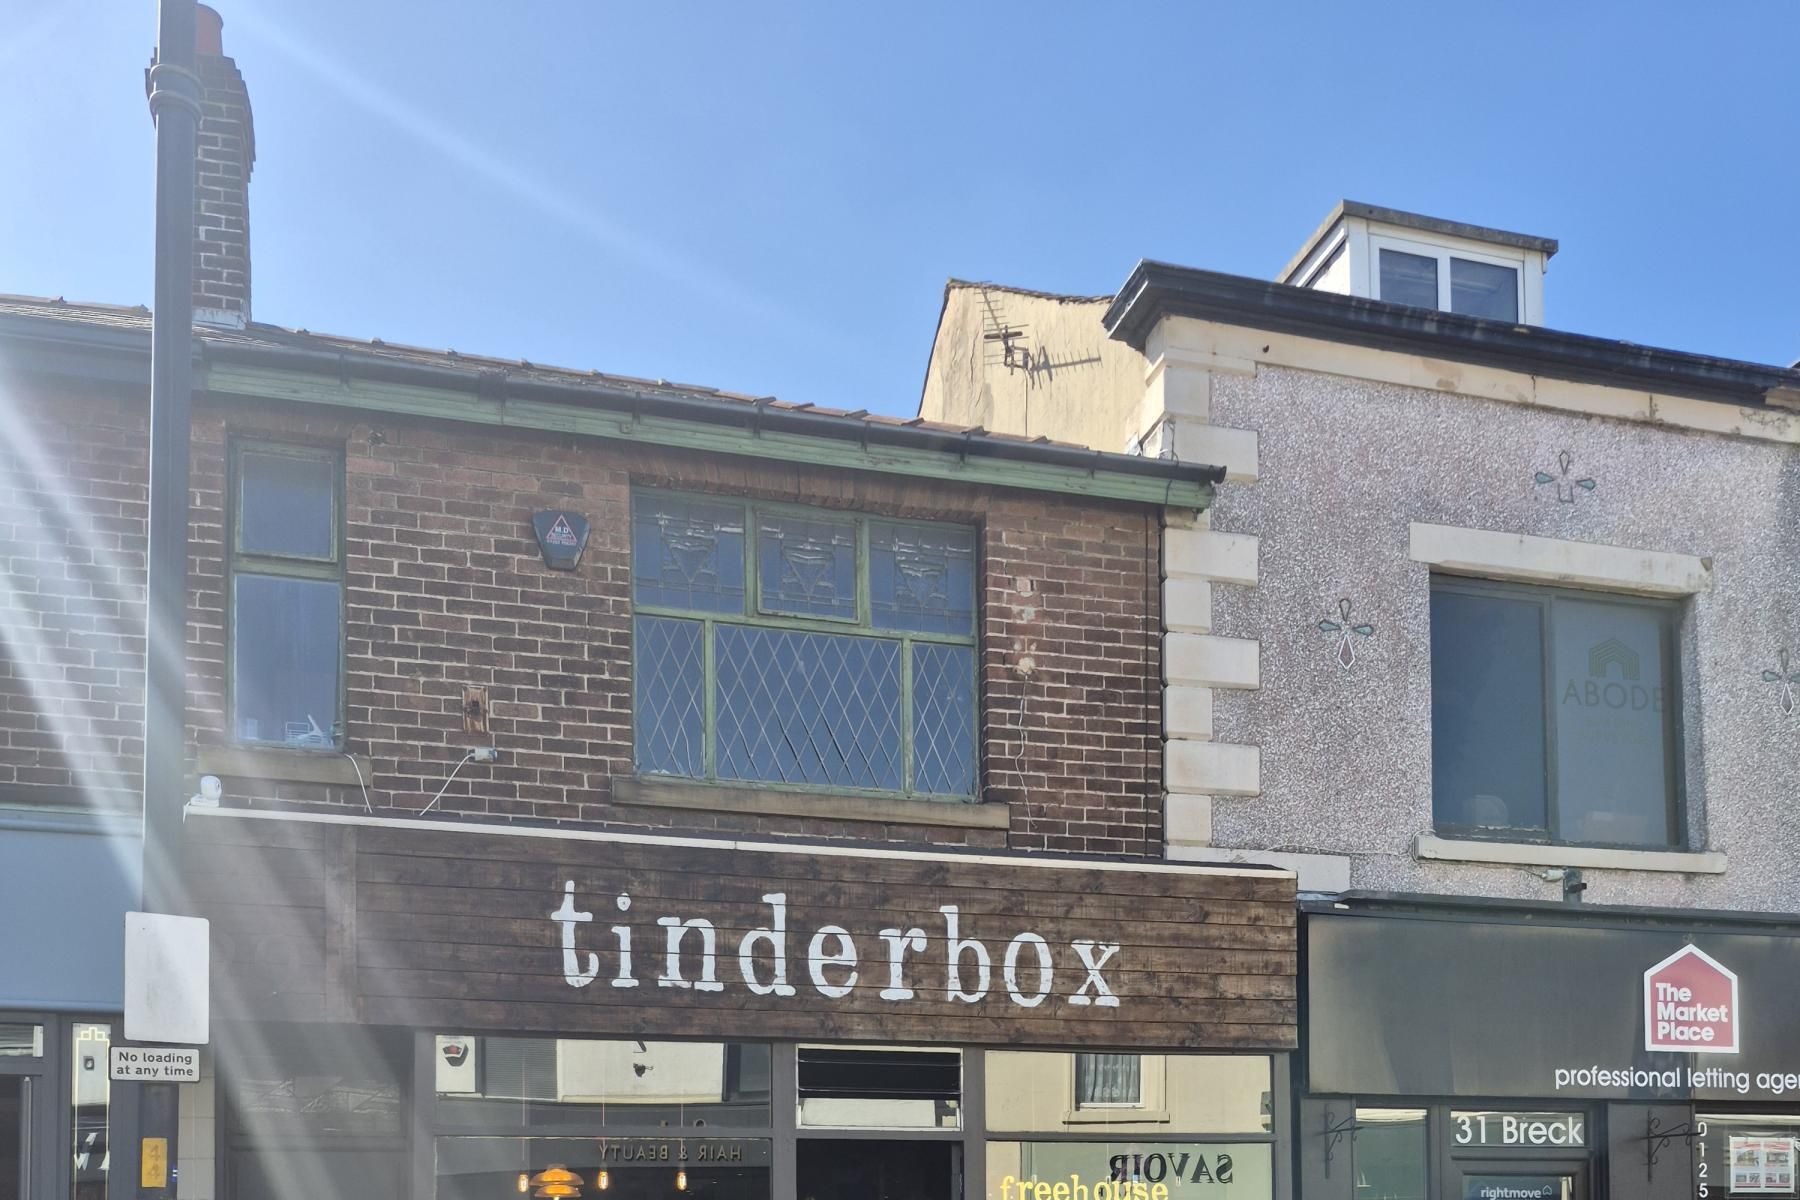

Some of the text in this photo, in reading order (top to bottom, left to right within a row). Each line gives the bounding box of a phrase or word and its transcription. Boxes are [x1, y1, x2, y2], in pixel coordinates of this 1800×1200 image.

[1562, 678, 1665, 713] ABODE
[550, 880, 1121, 1008] tinderbox
[1655, 982, 1692, 1002] The
[1657, 1002, 1729, 1023] Market
[1657, 1021, 1715, 1042] Place
[119, 1051, 193, 1065] No loading
[116, 1065, 194, 1077] at any time
[1555, 1065, 1800, 1095] professional letting age
[1455, 1115, 1584, 1144] 31 Breck
[1480, 1186, 1541, 1200] rightmove
